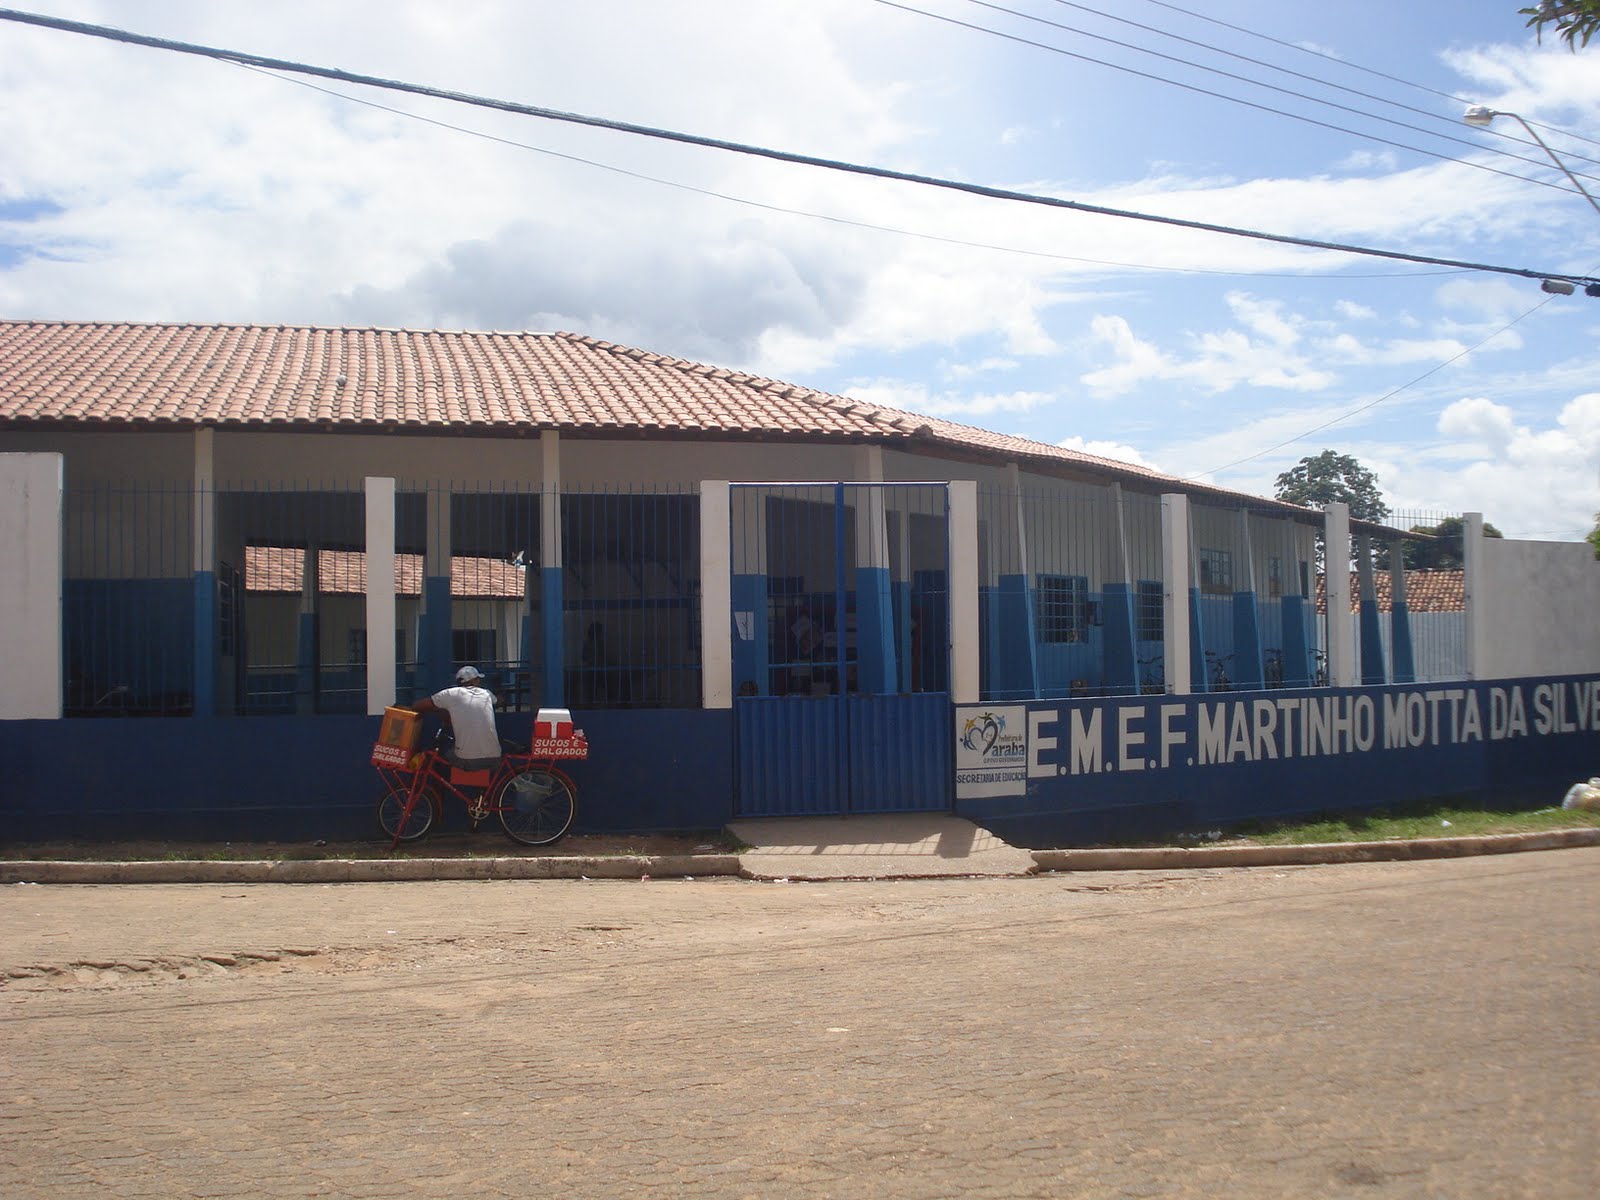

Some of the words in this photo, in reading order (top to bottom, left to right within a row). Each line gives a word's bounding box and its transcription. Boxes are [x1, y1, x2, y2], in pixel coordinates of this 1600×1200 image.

[1383, 689, 1483, 749] MOTTA
[1489, 686, 1528, 740] DA
[535, 739, 570, 747] SUCOS
[374, 744, 400, 756] SUCOS
[400, 750, 407, 758] E
[533, 747, 588, 756] SALGADOS
[372, 752, 407, 765] SALGADOS
[957, 773, 995, 784] SECRETARIA
[995, 772, 1002, 782] DE
